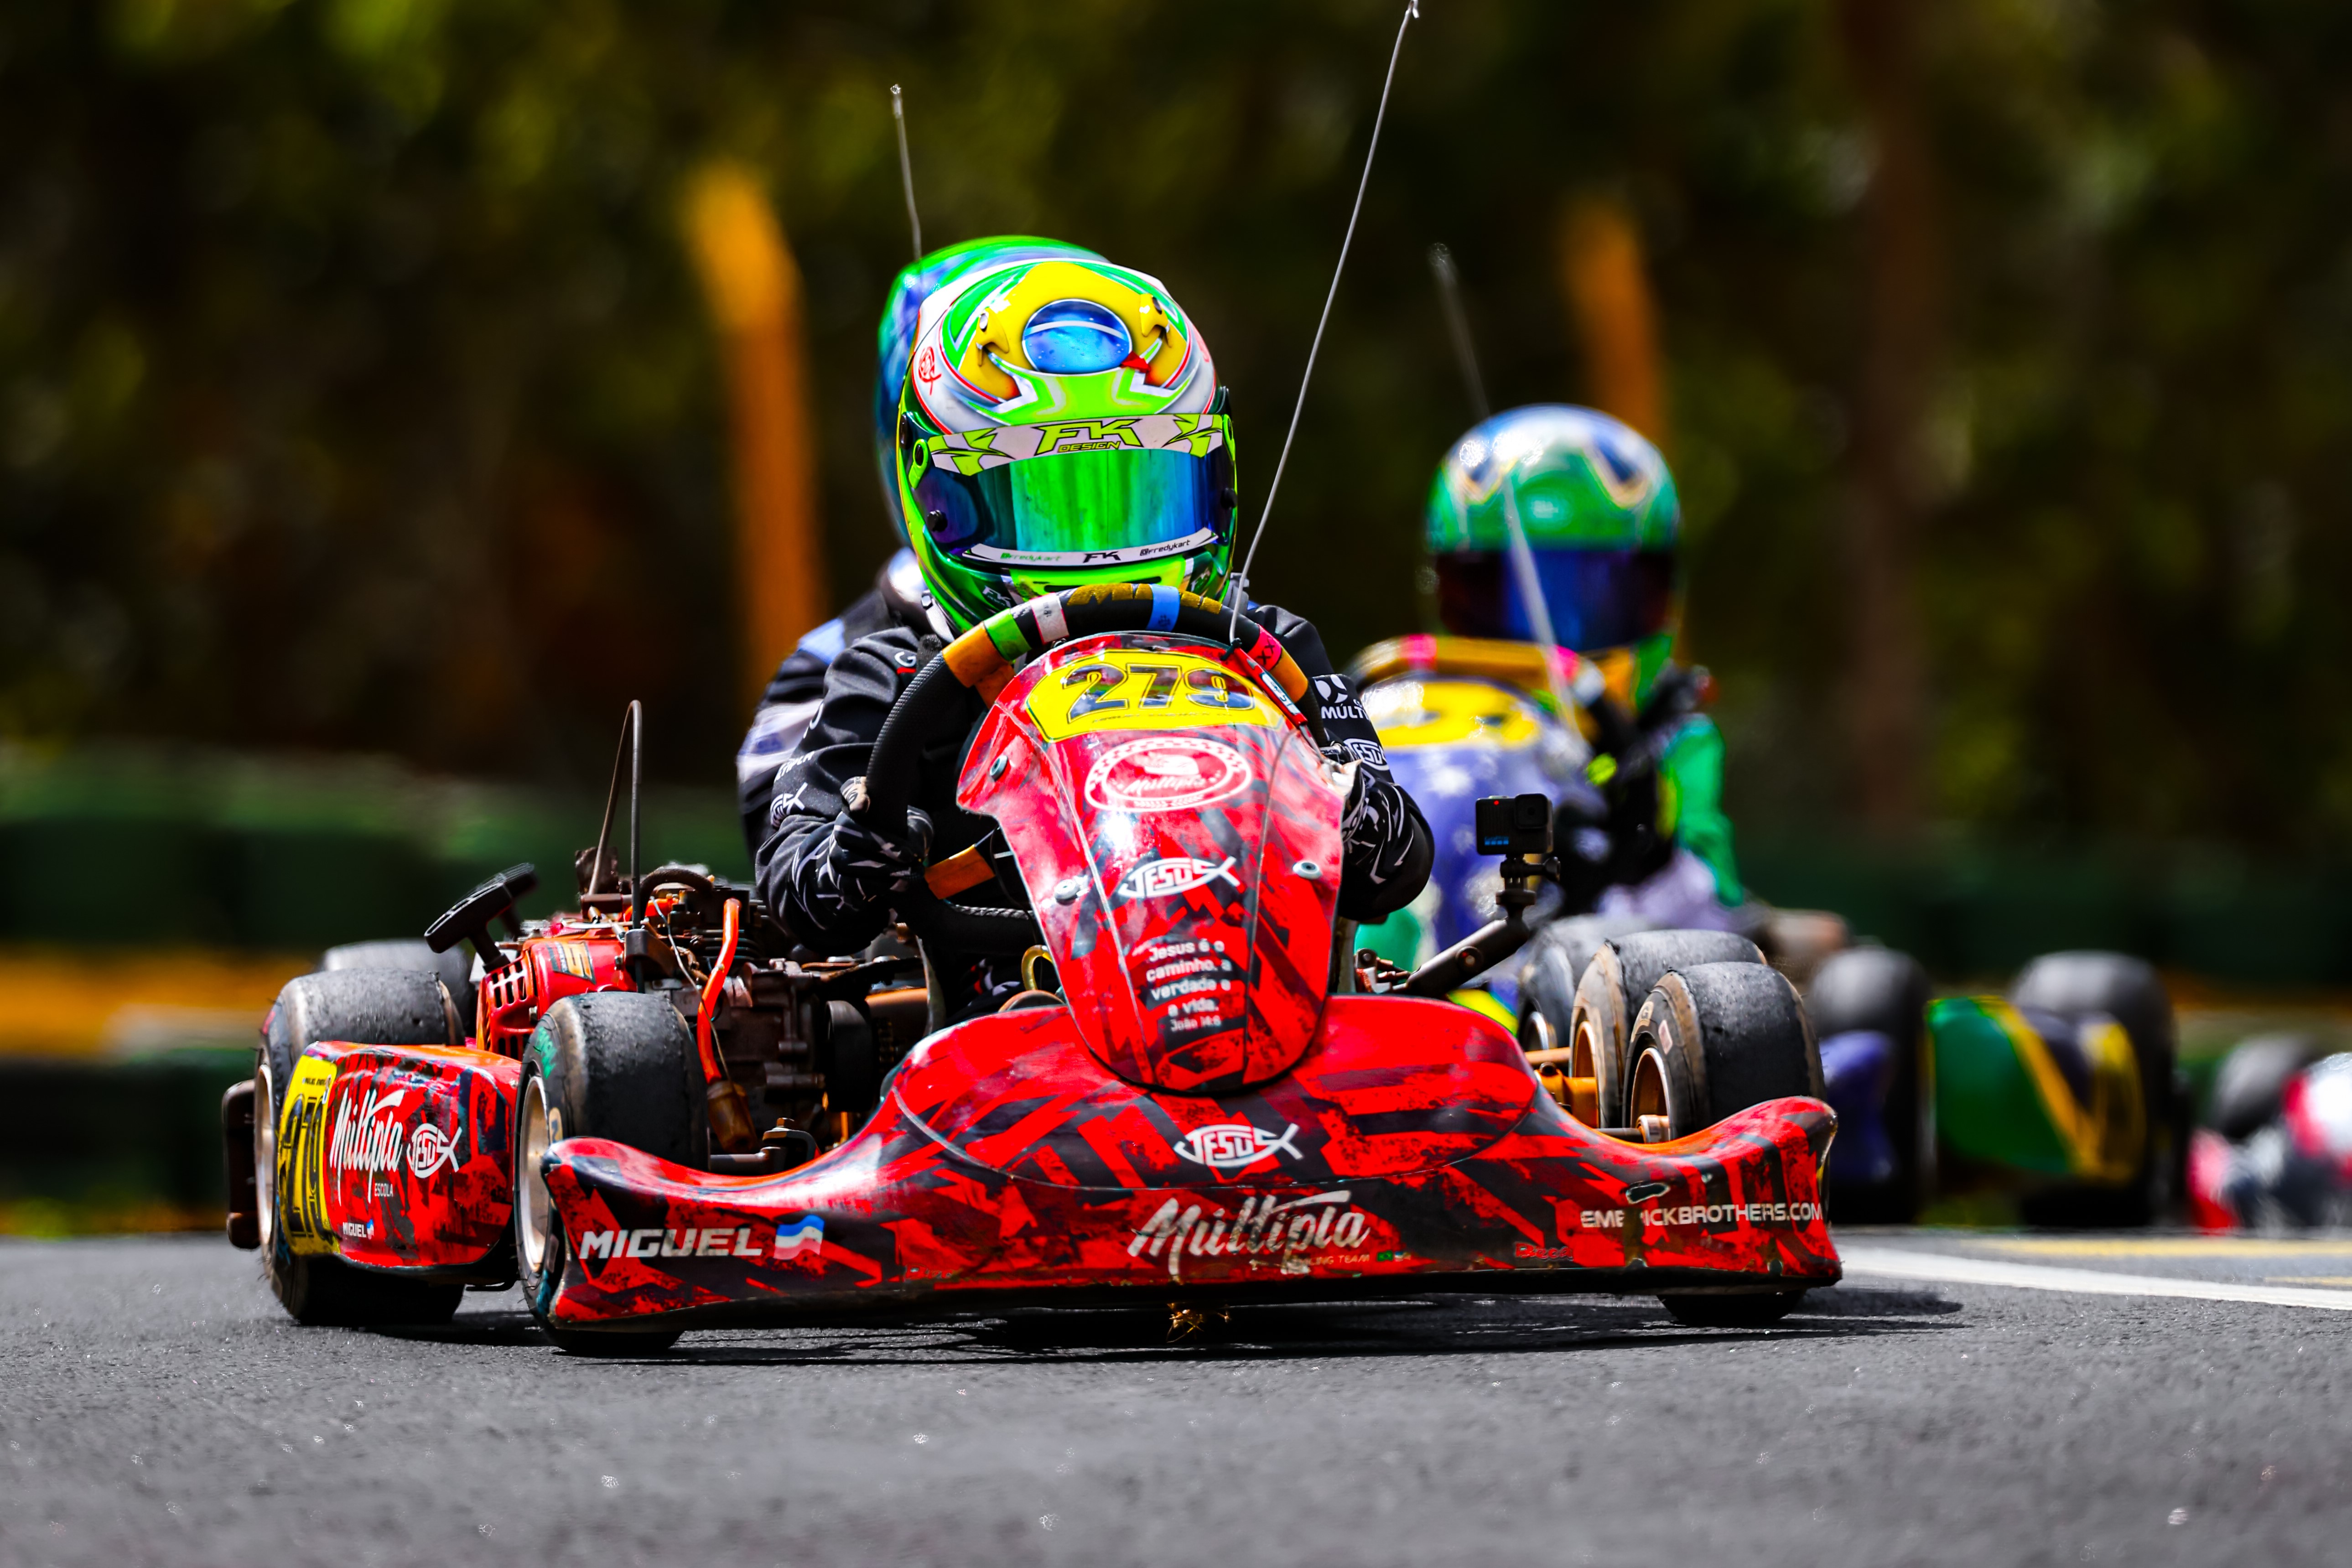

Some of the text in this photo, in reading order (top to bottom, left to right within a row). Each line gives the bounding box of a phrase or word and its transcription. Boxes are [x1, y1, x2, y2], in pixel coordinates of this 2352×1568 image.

[1031, 419, 1144, 456] FK
[1057, 441, 1121, 453] DESIGN
[1082, 551, 1121, 563] FK
[1063, 663, 1255, 724] 279
[1118, 856, 1240, 898] JESUS
[1149, 938, 1225, 962] Jesus é o
[1221, 959, 1232, 971] a
[1151, 977, 1231, 1001] verdade e
[1168, 1004, 1179, 1017] a
[1173, 1123, 1303, 1168] JESUS
[374, 1183, 394, 1197] ESCOLA
[1580, 1202, 1823, 1228] EMEICKBROTHERS.COM
[343, 1221, 367, 1237] MIGUEL
[579, 1228, 763, 1259] MIGUEL
[1338, 1254, 1370, 1264] TEAM
